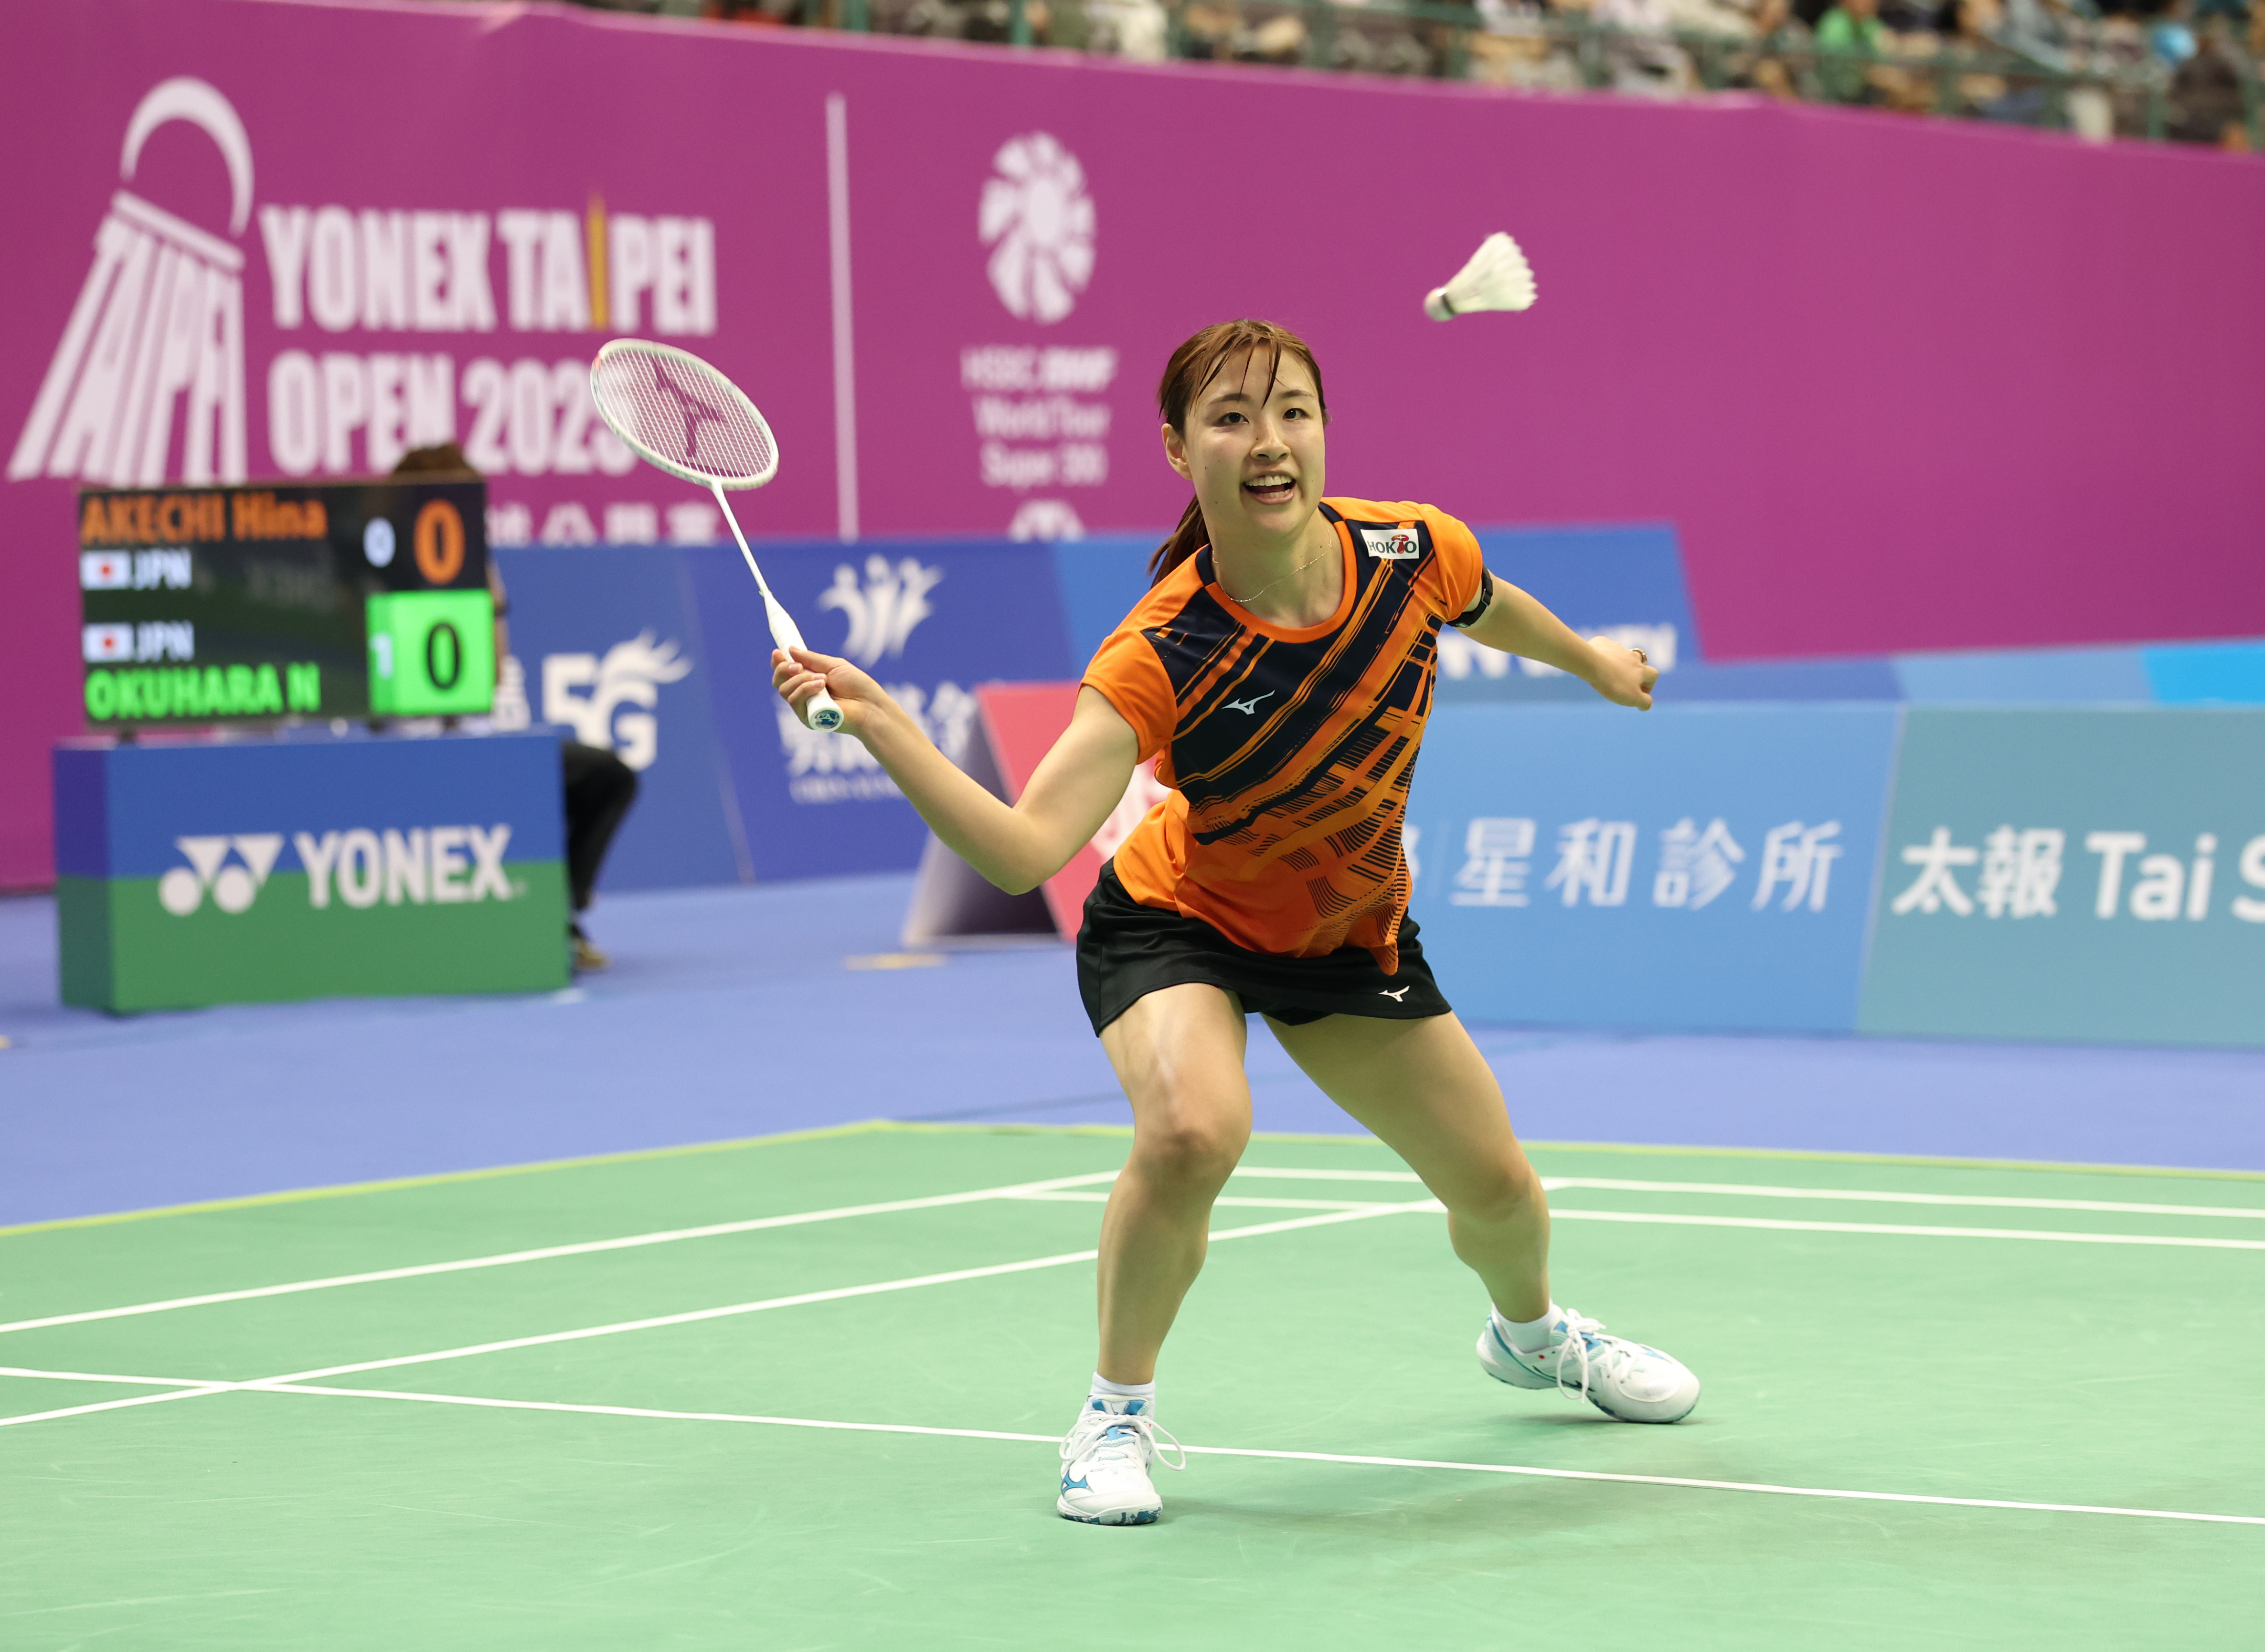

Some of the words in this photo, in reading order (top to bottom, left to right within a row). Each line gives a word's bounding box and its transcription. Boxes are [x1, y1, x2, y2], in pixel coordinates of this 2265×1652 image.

[258, 205, 497, 332] YONEX
[496, 193, 717, 336] TAIPEI
[266, 349, 457, 476] OPEN
[80, 493, 225, 544] AKECHI
[232, 492, 328, 540] Hina
[364, 517, 396, 567] 0
[414, 499, 465, 585] 0
[132, 548, 192, 590] JPN
[134, 621, 194, 663] JPN
[371, 633, 394, 680] 1
[425, 622, 462, 691] 0
[84, 661, 284, 720] OKUHARA
[287, 662, 321, 712] N
[541, 651, 659, 772] 5G
[294, 824, 513, 908] YONEX
[1450, 817, 1843, 911] 星和診所
[1892, 824, 2066, 919] 太報
[2085, 830, 2217, 921] Tai
